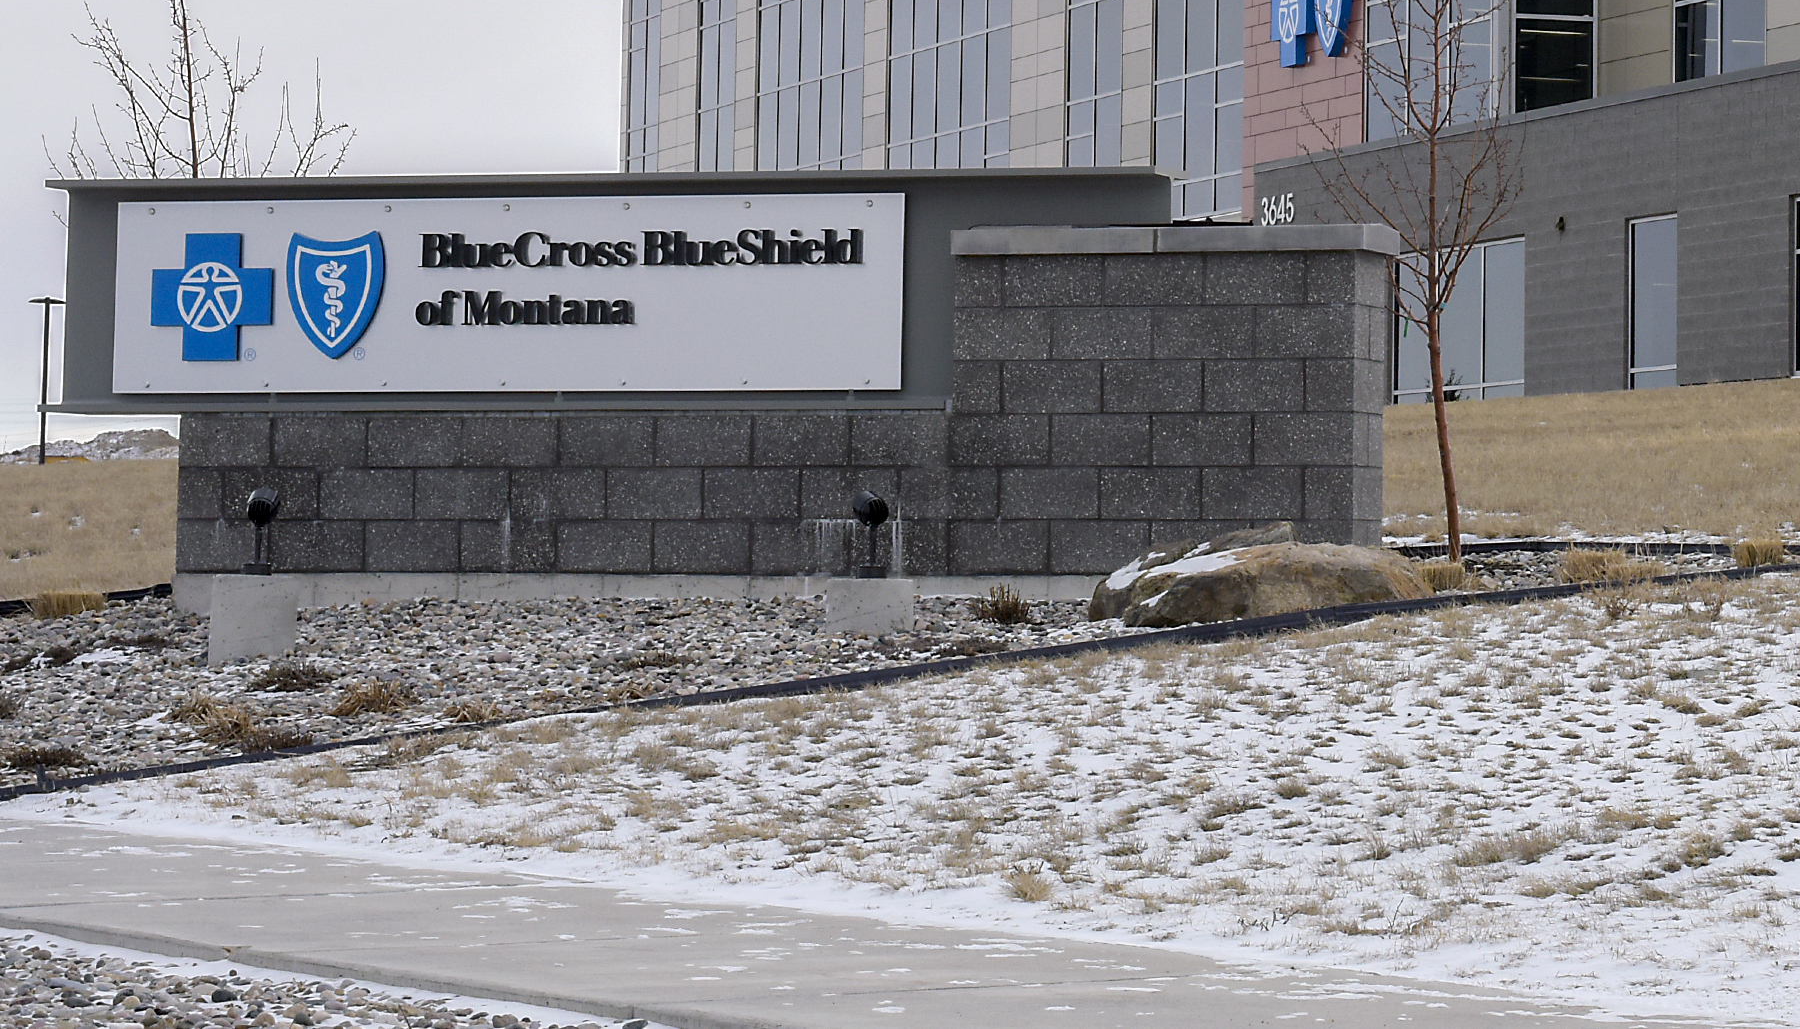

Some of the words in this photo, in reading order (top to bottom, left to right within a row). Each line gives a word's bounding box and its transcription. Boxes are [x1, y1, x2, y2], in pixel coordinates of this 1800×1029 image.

[1261, 192, 1294, 226] 3645
[418, 232, 638, 268] BlueCross
[640, 229, 864, 266] BlueShield
[415, 289, 461, 326] of
[461, 290, 637, 326] Montana
